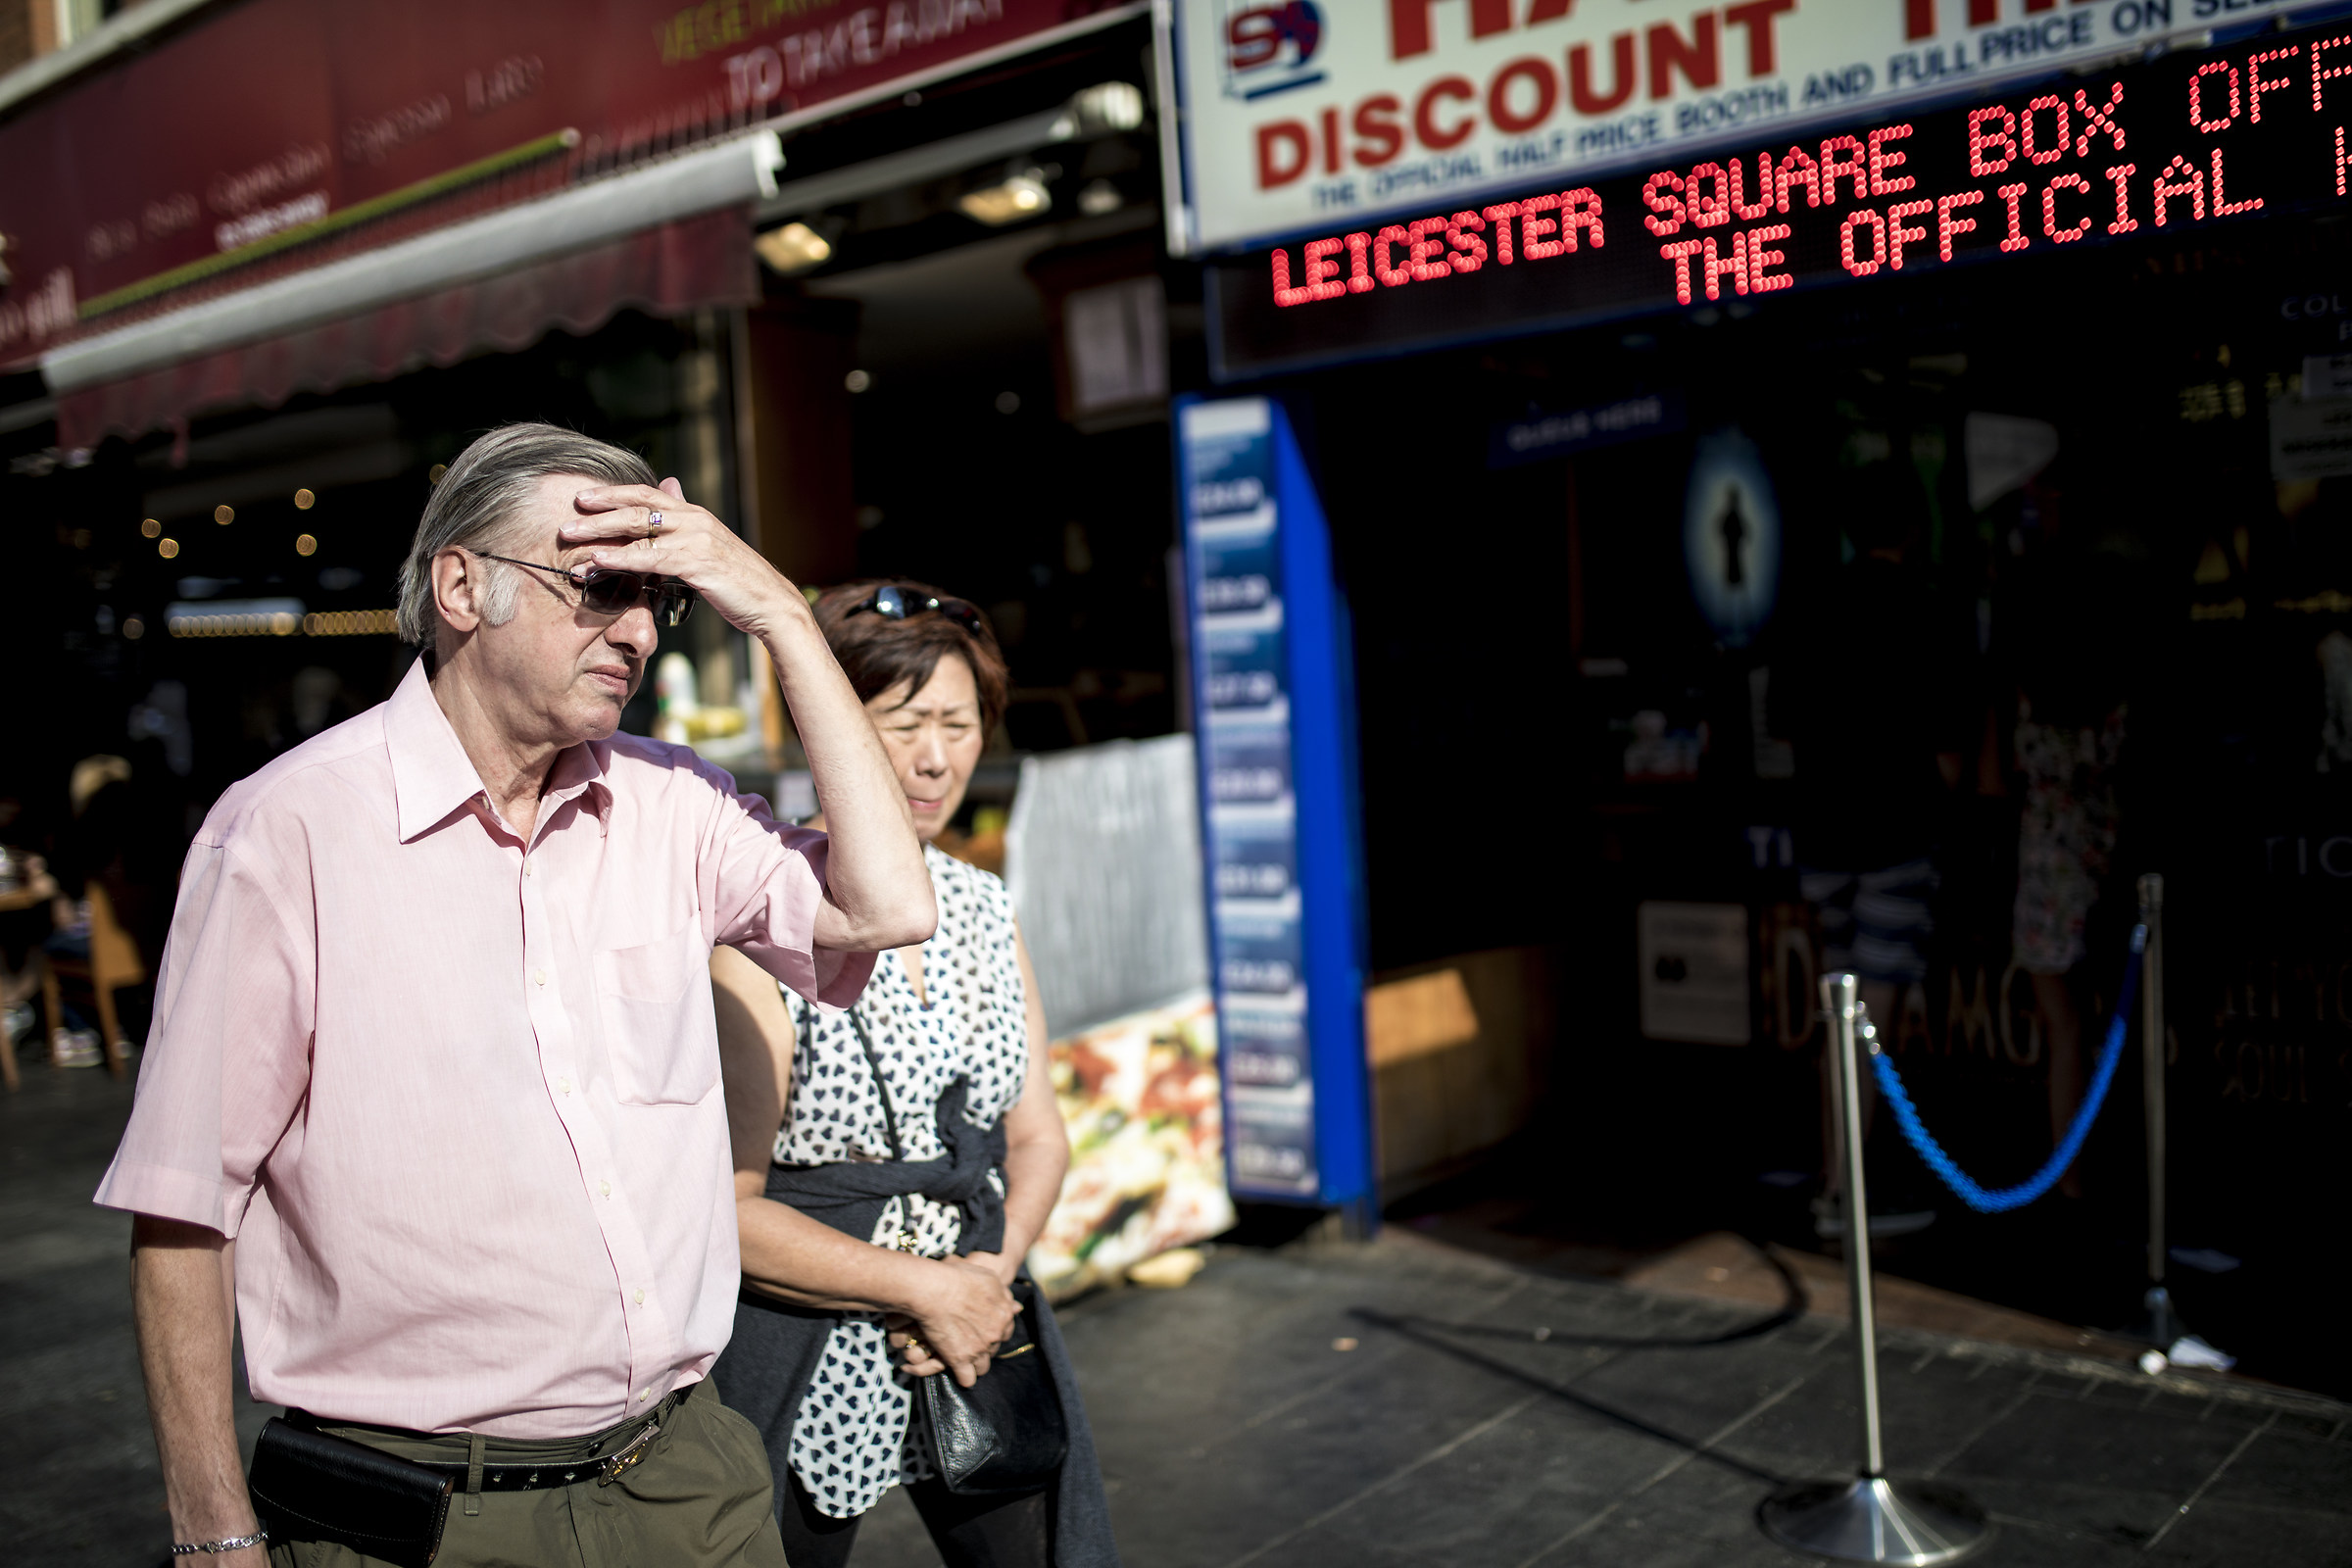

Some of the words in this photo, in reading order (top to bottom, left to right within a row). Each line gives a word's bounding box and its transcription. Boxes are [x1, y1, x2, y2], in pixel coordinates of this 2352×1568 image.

[1252, 0, 1797, 194] DISCOUNT
[1674, 78, 1789, 134] BOOTH
[1799, 59, 1876, 105] AND
[1886, 41, 1974, 88] FULL
[1979, 10, 2094, 65] PRICE
[2112, 0, 2172, 37] ON
[1272, 187, 1604, 308] LEICESTER
[1642, 123, 1915, 237] SQUARE
[1968, 81, 2127, 178] BOX
[1659, 223, 1794, 306] THE
[1839, 147, 2265, 277] OFFICIAL
